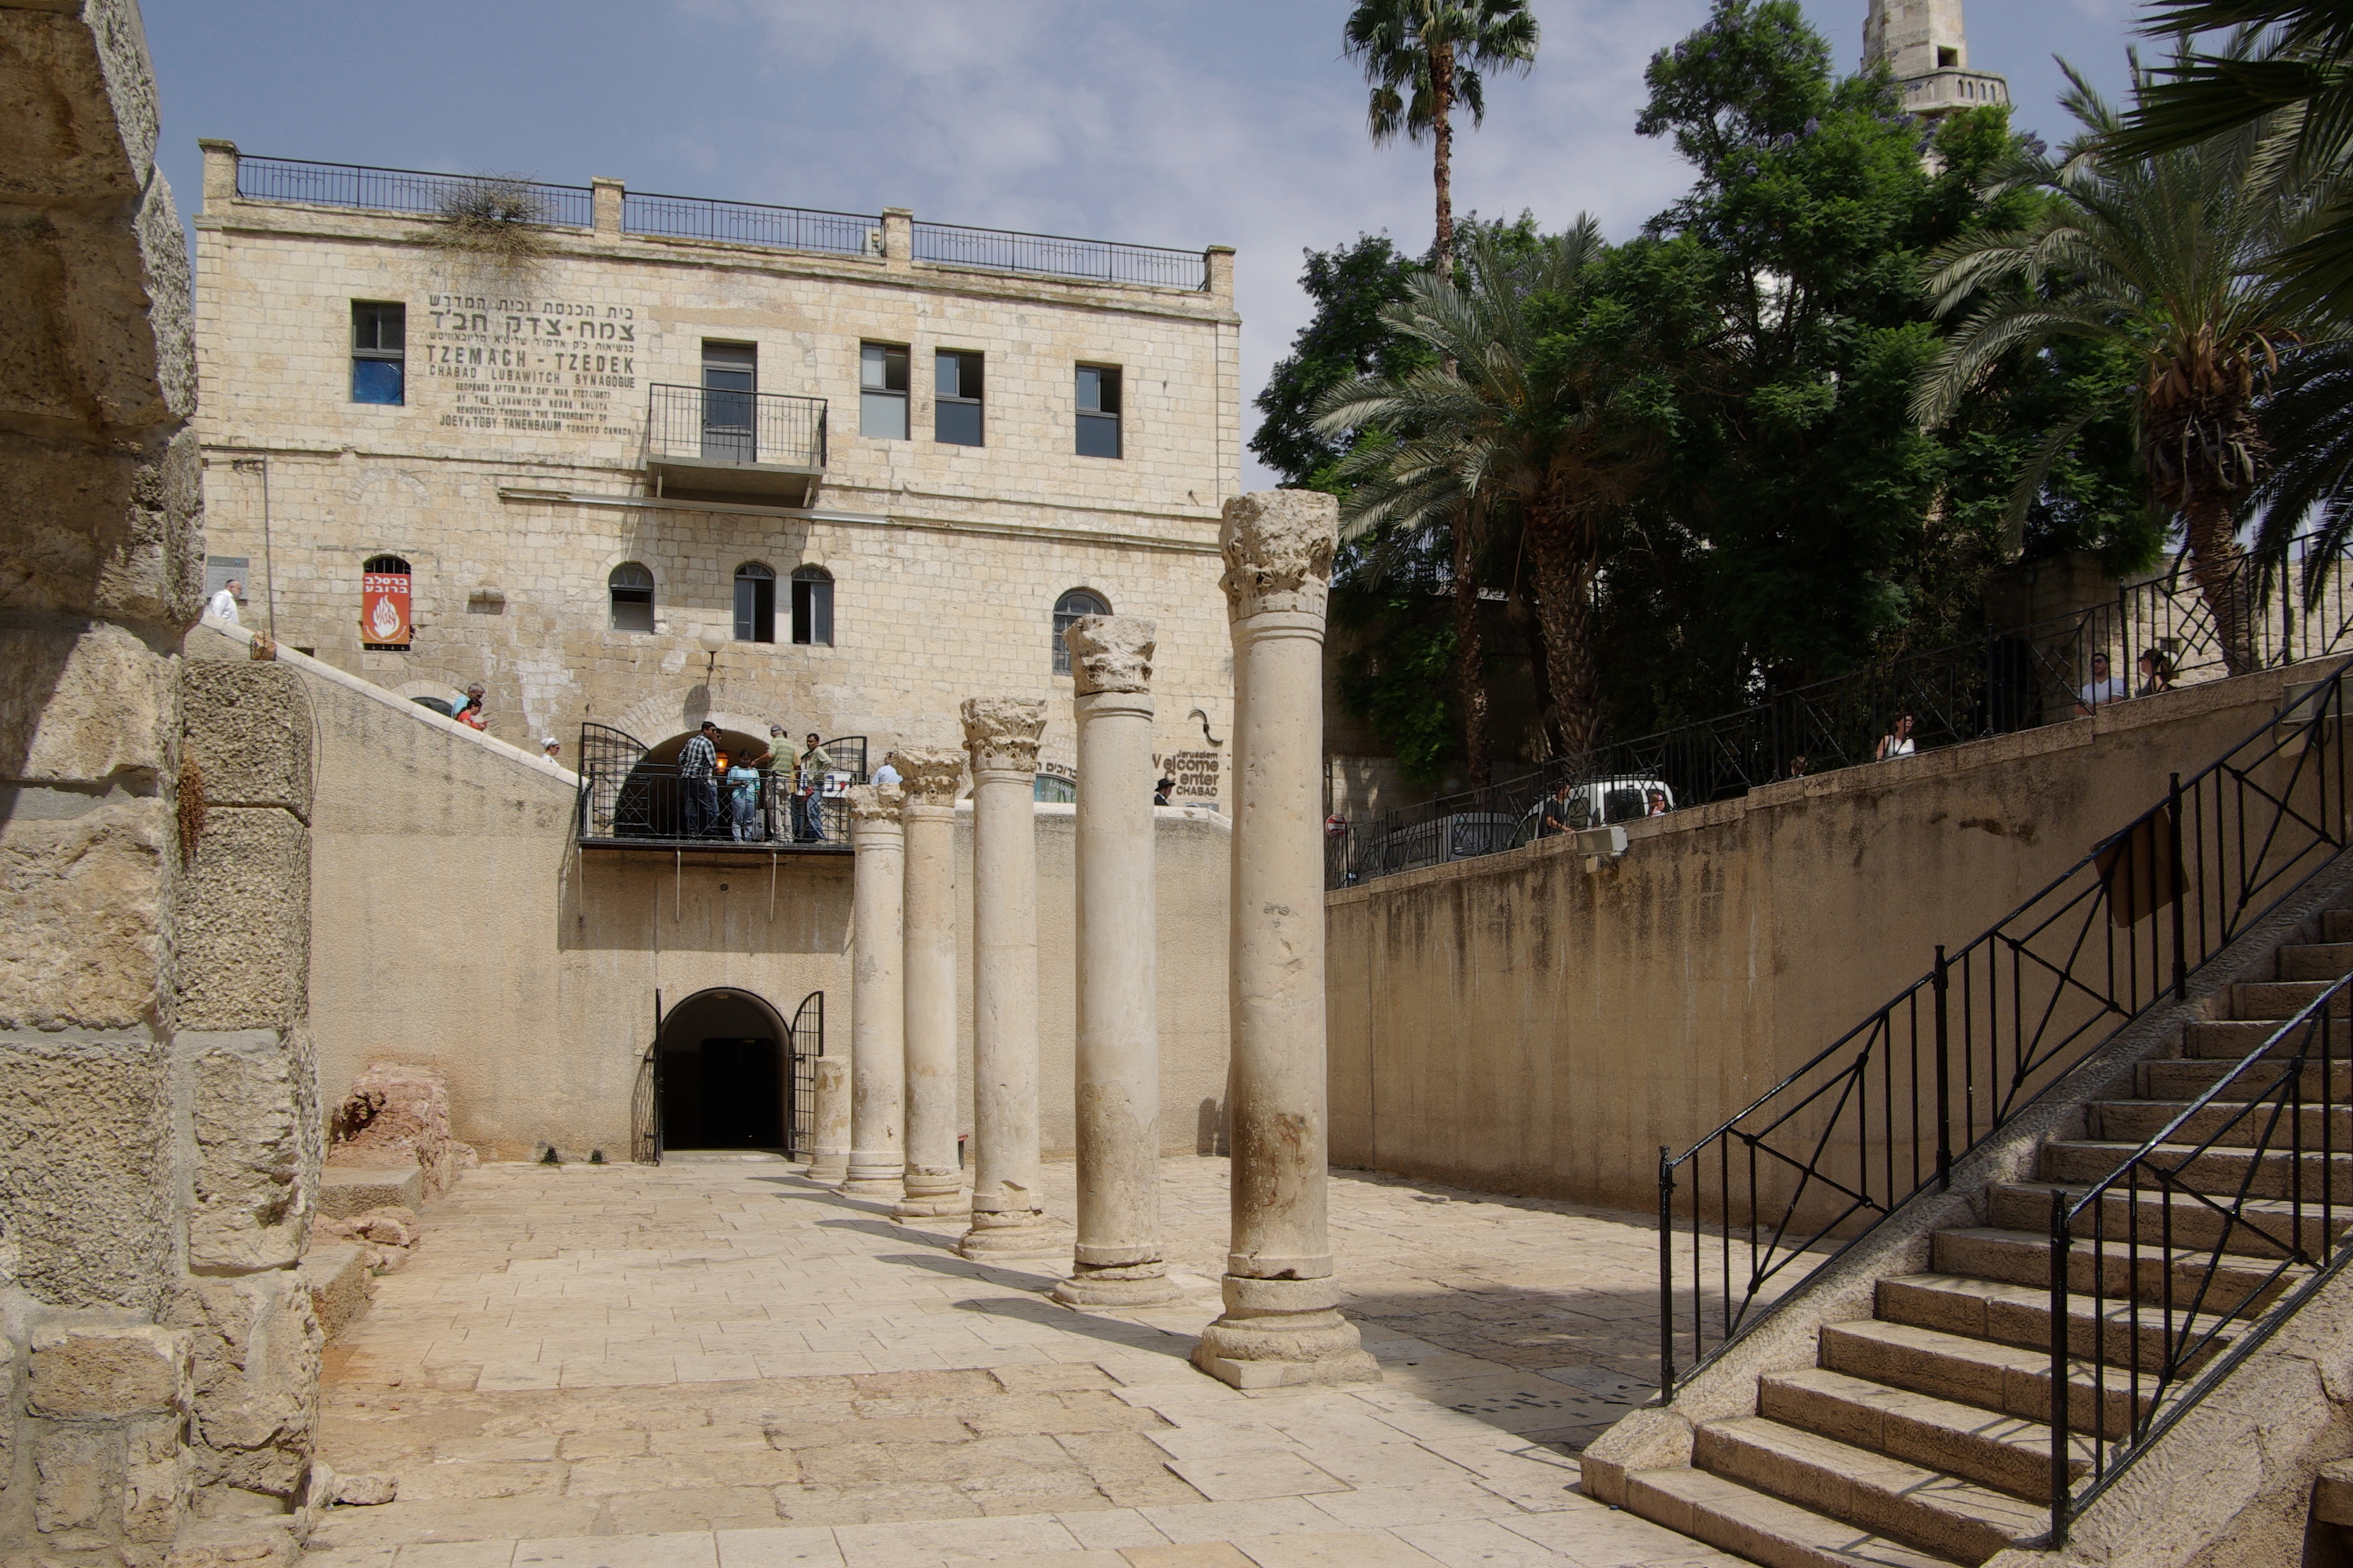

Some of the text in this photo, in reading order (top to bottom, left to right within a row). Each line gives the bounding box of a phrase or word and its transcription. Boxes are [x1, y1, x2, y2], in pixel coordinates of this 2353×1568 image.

[430, 294, 633, 320] בית הכנסת ובית המדרש
[596, 342, 634, 353] בנשיאות
[427, 345, 525, 367] TZEMACH
[555, 353, 634, 374] TZEDEK
[430, 365, 635, 388] CHABAD LUBAWITCH SYNAGOGUE
[455, 382, 489, 392] REOPENED
[494, 384, 515, 393] AFTER
[521, 386, 531, 394] SIX
[555, 388, 568, 396] WAR
[475, 396, 488, 404] THE
[497, 397, 541, 407] LUBAWITCH
[549, 400, 572, 409] REBBE
[581, 402, 607, 411] SHLITA
[457, 406, 495, 415] RENOVATED
[500, 408, 531, 417] THROUGH
[553, 411, 594, 421] GENEROSITY
[439, 415, 464, 427] JOEY
[472, 416, 498, 428] TOBY
[503, 417, 561, 431] TANENBAUM
[566, 424, 599, 433] TORONTO
[604, 427, 631, 436] CANADA
[365, 576, 408, 586] ברסלב
[1176, 750, 1218, 760] Jerusalem
[1165, 769, 1219, 785] Center
[1049, 779, 1072, 797] Living
[1176, 785, 1218, 797] CHABAD
